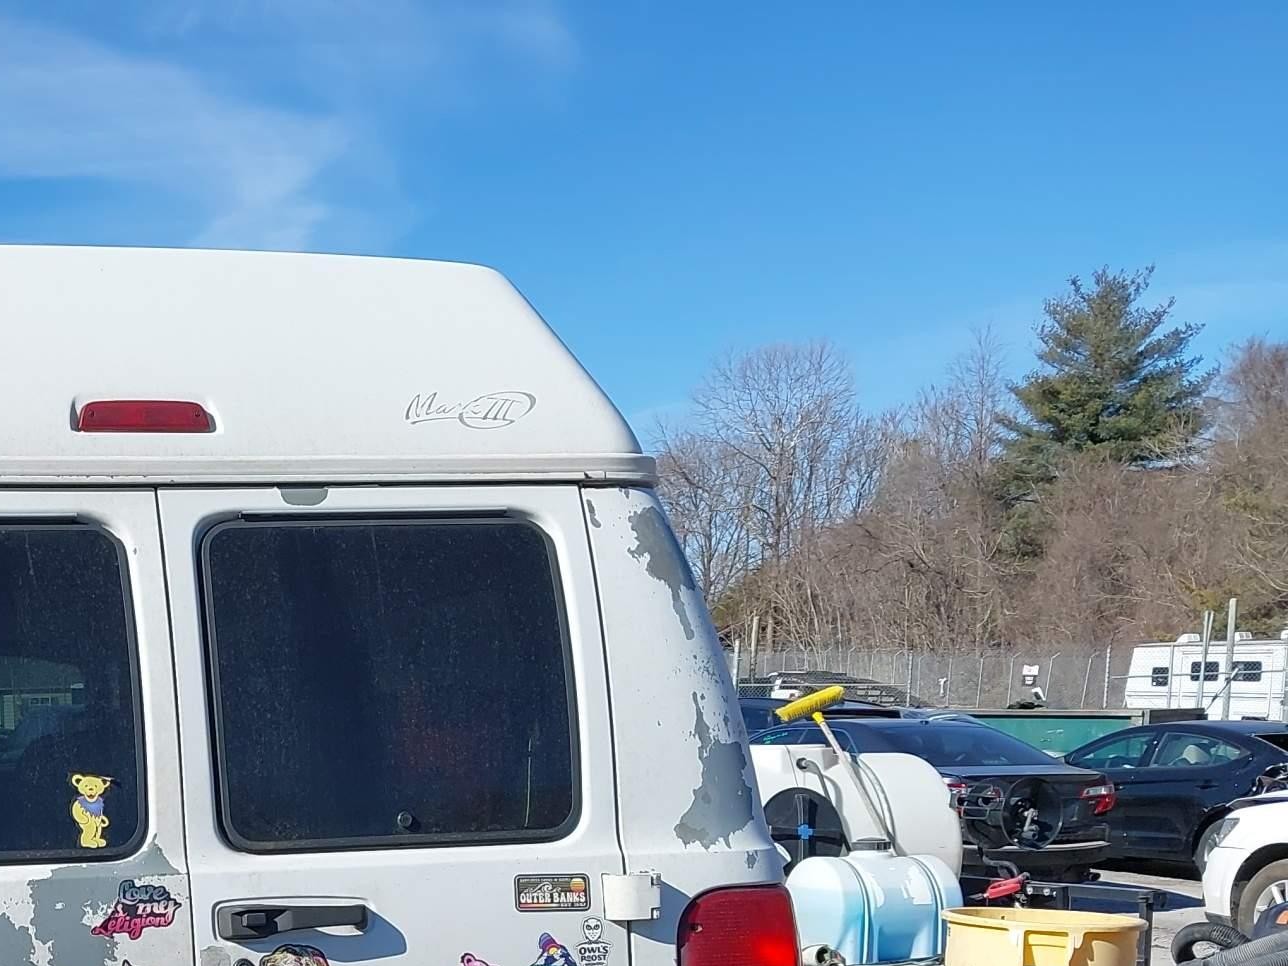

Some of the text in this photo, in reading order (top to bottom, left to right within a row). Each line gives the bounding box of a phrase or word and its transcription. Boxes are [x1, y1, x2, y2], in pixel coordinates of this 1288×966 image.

[119, 881, 169, 905] Love
[519, 891, 586, 903] OUTER BANKS
[578, 945, 609, 955] OWL'S
